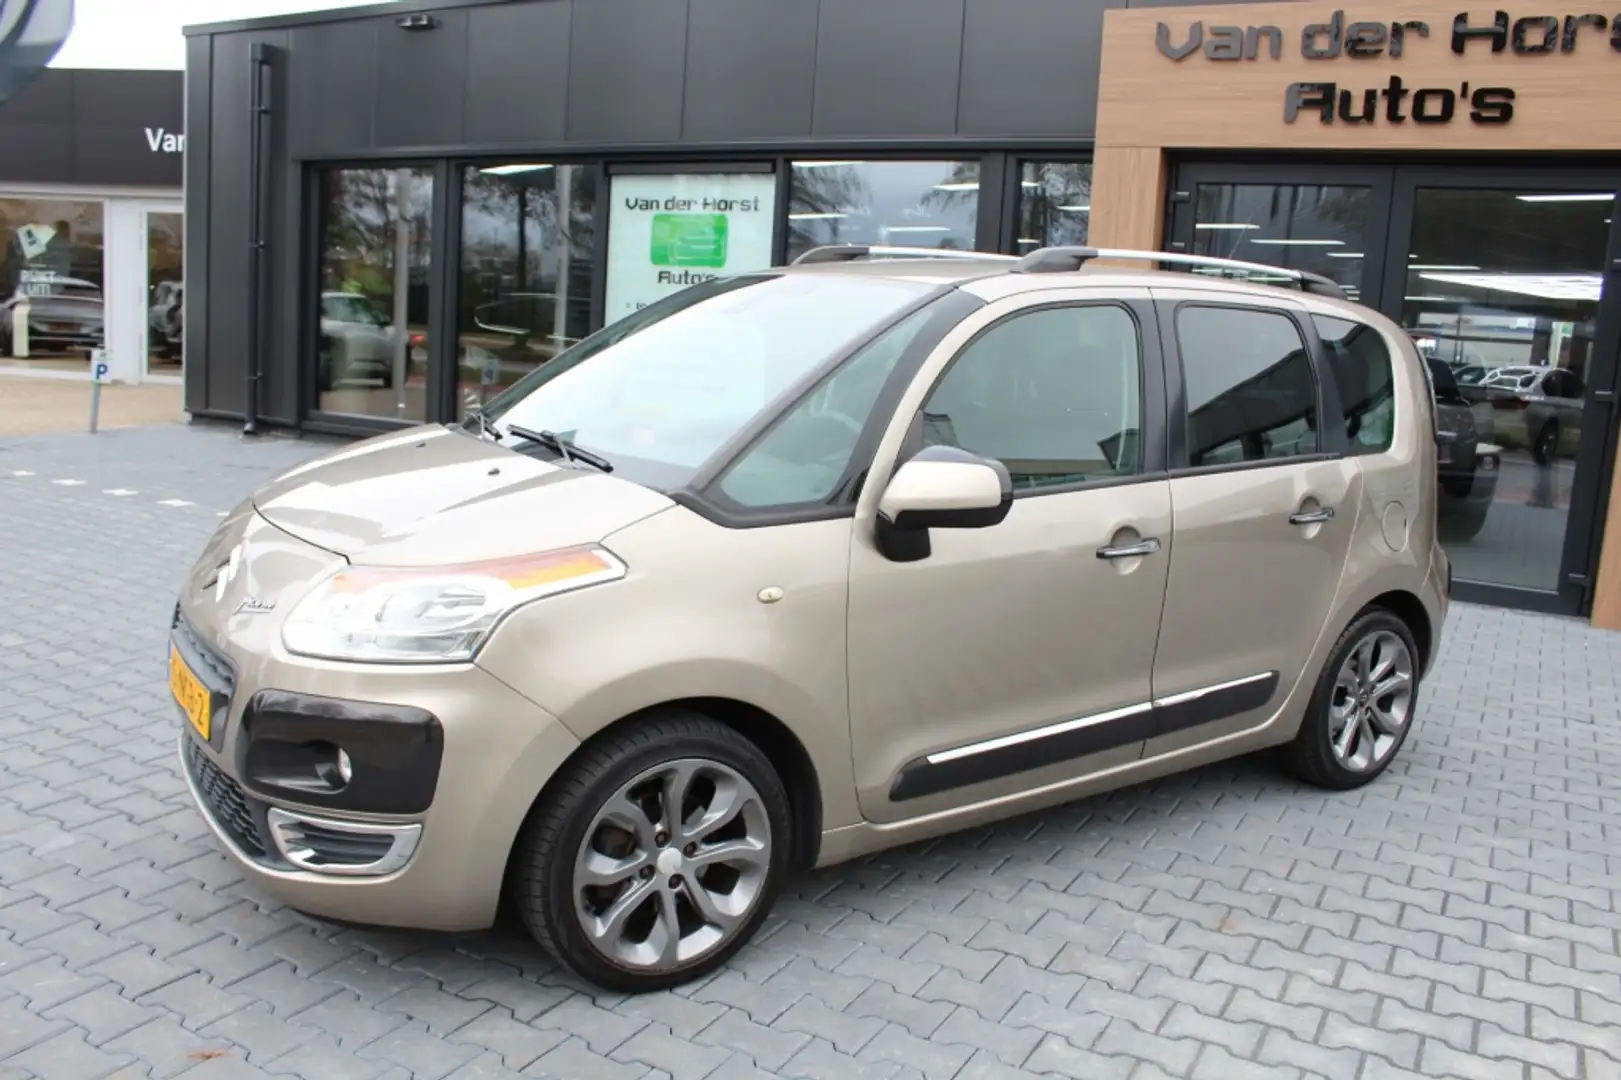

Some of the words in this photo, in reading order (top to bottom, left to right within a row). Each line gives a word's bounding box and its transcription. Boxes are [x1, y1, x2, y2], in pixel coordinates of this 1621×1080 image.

[1155, 20, 1283, 62] Van
[1301, 9, 1430, 60] der
[1450, 10, 1621, 56] Hor
[1283, 75, 1516, 126] Auto's
[625, 197, 660, 211] Van
[664, 195, 698, 211] der
[702, 195, 760, 212] Horst
[96, 363, 108, 380] P
